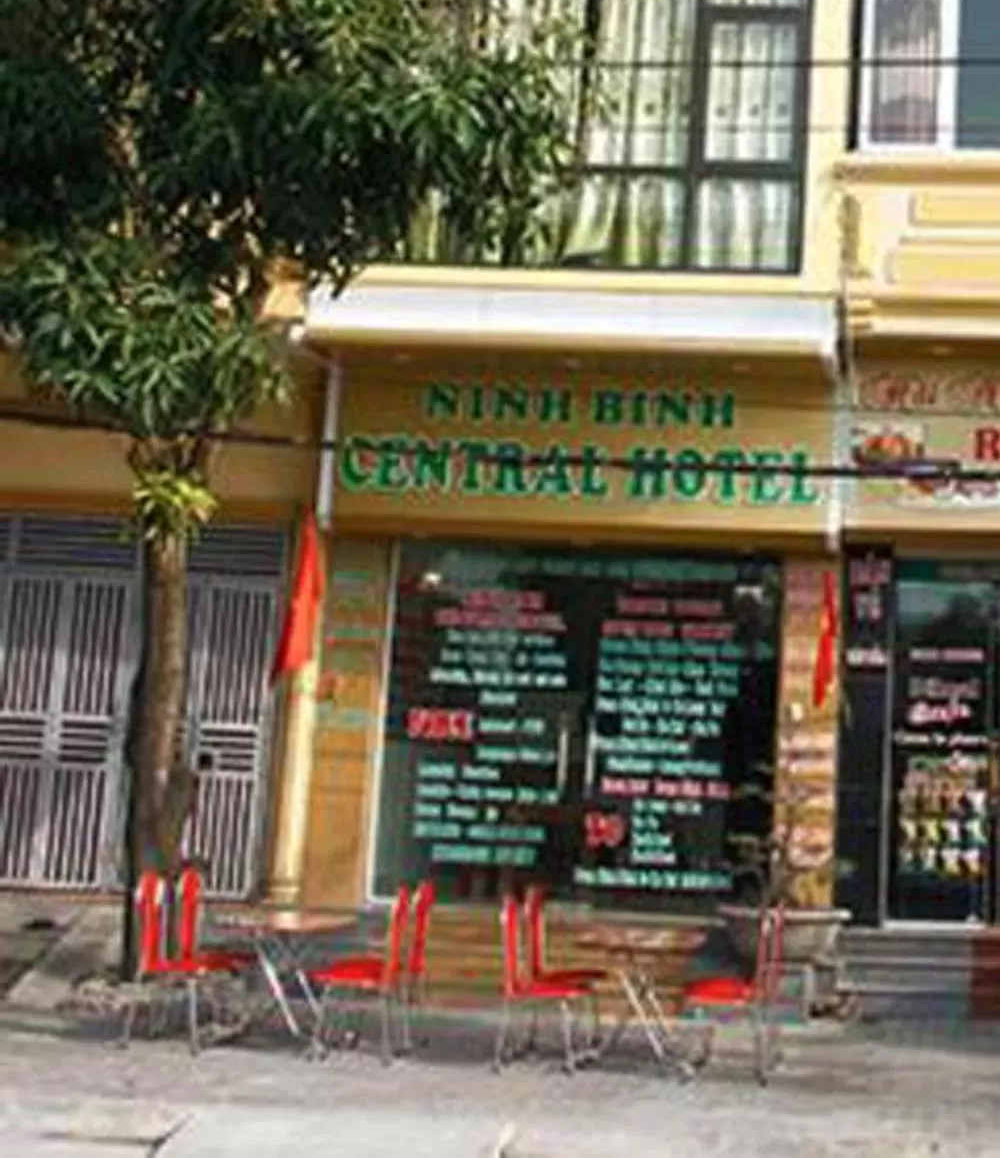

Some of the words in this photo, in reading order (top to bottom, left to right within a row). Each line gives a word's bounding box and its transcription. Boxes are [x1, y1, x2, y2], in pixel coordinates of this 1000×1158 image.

[425, 382, 573, 422] NINH
[593, 388, 735, 429] BINH
[339, 436, 608, 497] CENTRAL
[631, 445, 821, 505] HOTEL
